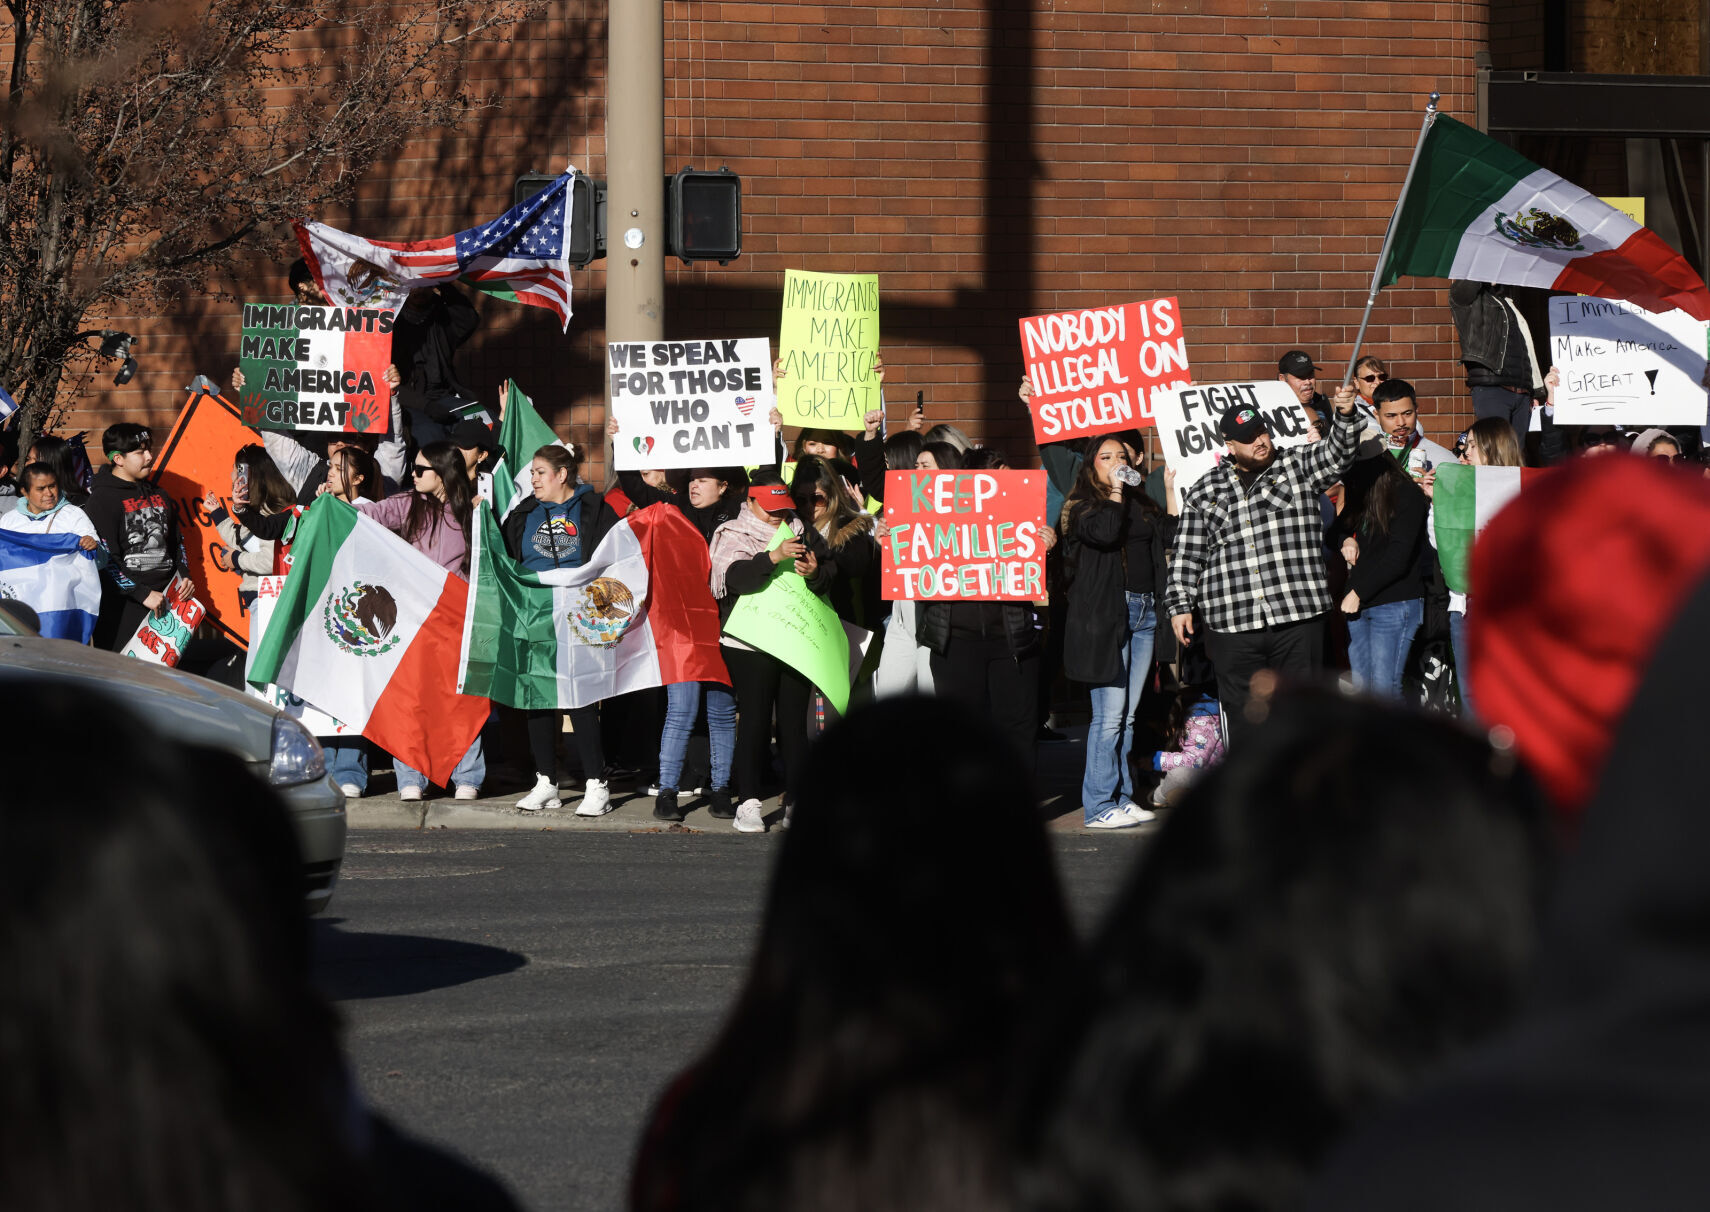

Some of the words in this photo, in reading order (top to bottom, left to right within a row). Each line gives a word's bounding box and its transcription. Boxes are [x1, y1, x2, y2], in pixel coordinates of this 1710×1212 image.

[786, 276, 878, 312] IMMIGRANTS
[242, 304, 394, 334] IMMIGRANTS
[810, 317, 869, 349] MAKE
[1024, 306, 1125, 358] NOBODY
[1140, 299, 1175, 338] IS
[241, 335, 311, 362] MAKE
[609, 344, 646, 368] WE
[652, 340, 740, 366] SPEAK
[1558, 334, 1606, 361] Make
[263, 367, 375, 396] AMERICA
[611, 371, 666, 397] FOR
[669, 367, 761, 395] THOSE
[785, 349, 877, 383] AMERICA
[1030, 348, 1129, 397] ILLEGAL
[1139, 337, 1189, 377] ON
[1568, 370, 1633, 392] GREAT
[265, 400, 351, 426] GREAT
[650, 399, 710, 424] WHO
[795, 385, 872, 419] GREAT
[1040, 389, 1132, 436] STOLEN
[1179, 385, 1260, 422] FIGHT
[673, 421, 754, 453] CAN'T
[1175, 405, 1308, 457] IGNNCE
[910, 473, 998, 513] KEEP
[889, 521, 1036, 565] FAMILIES
[896, 561, 1041, 598] TOGETHER
[137, 625, 159, 655] ARE
